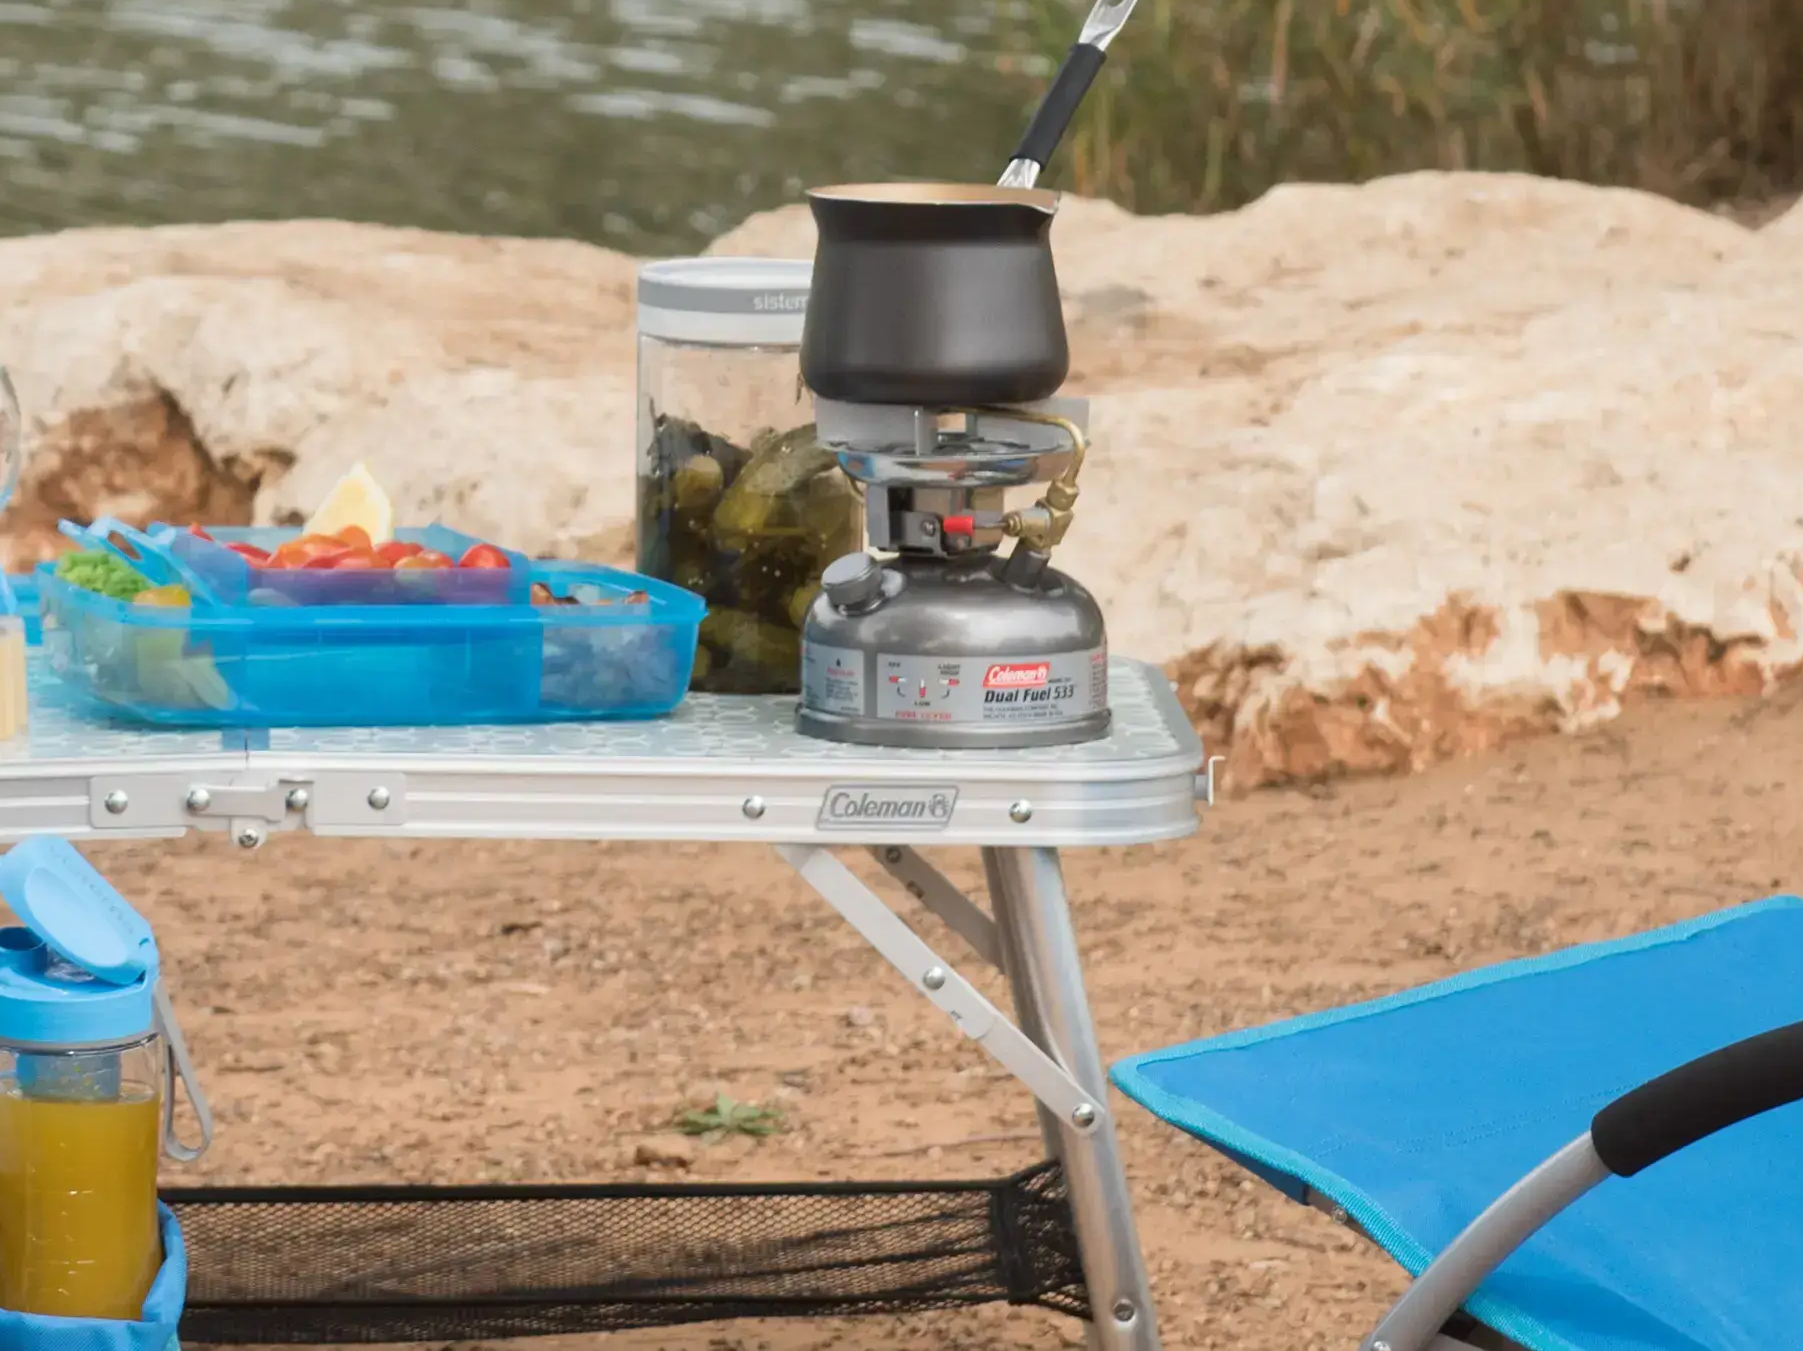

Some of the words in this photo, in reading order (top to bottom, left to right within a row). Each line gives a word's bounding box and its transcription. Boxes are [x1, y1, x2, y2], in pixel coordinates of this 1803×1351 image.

[989, 665, 1037, 683] Coleman
[984, 689, 1019, 704] Dual
[1022, 686, 1052, 702] Fuel
[1052, 684, 1075, 700] 533
[830, 792, 927, 818] Coleman
